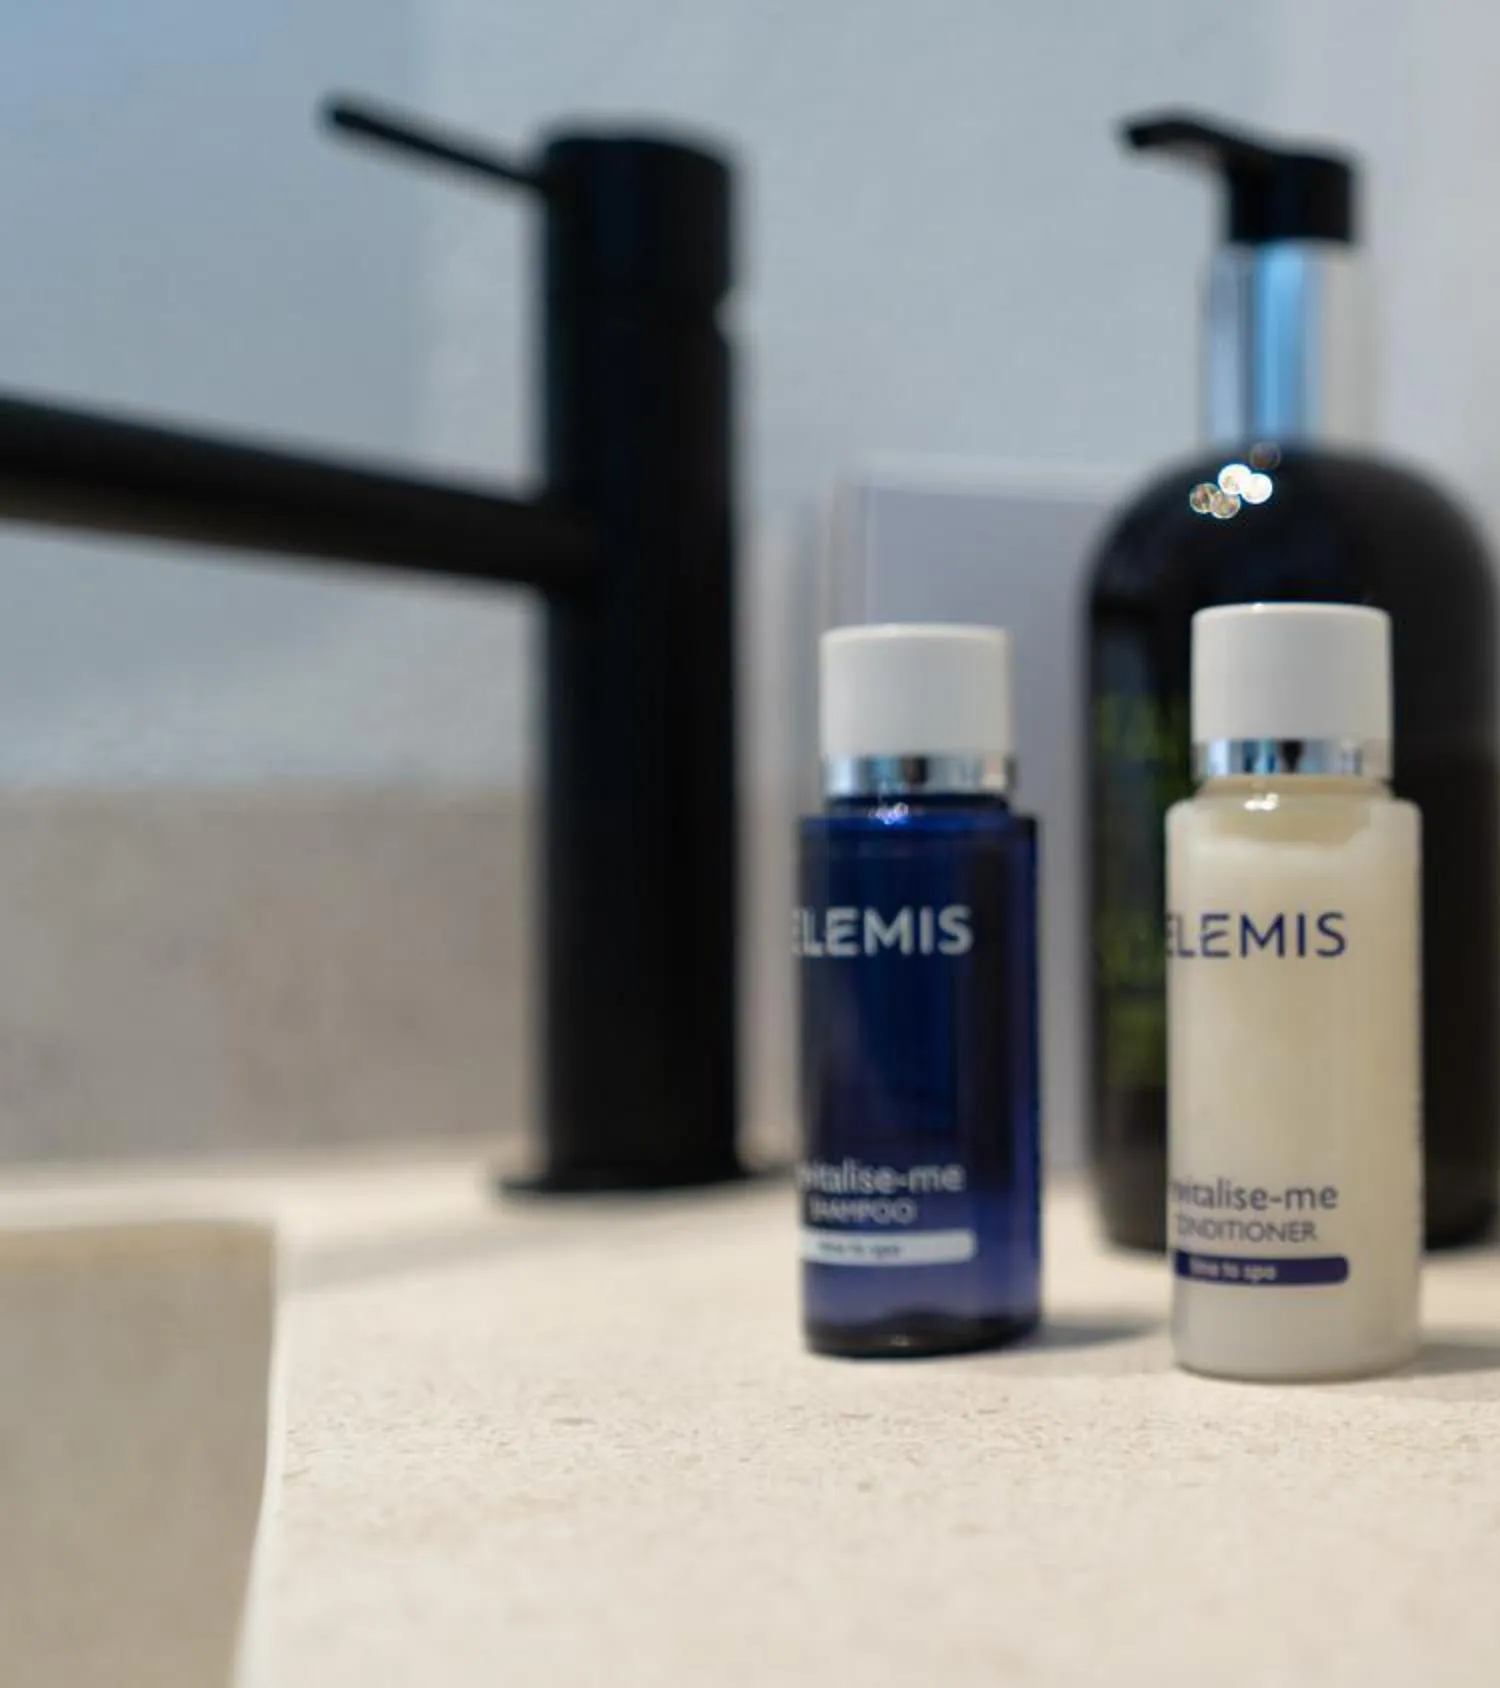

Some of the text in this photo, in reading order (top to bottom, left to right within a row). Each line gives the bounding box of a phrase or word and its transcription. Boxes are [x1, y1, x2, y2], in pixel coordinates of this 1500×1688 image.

[798, 1156, 966, 1195] italise-me
[1171, 1176, 1338, 1211] italise-me
[809, 1195, 918, 1225] AMPOO
[1177, 1216, 1318, 1243] ONDITIONER
[1244, 1264, 1278, 1284] spa
